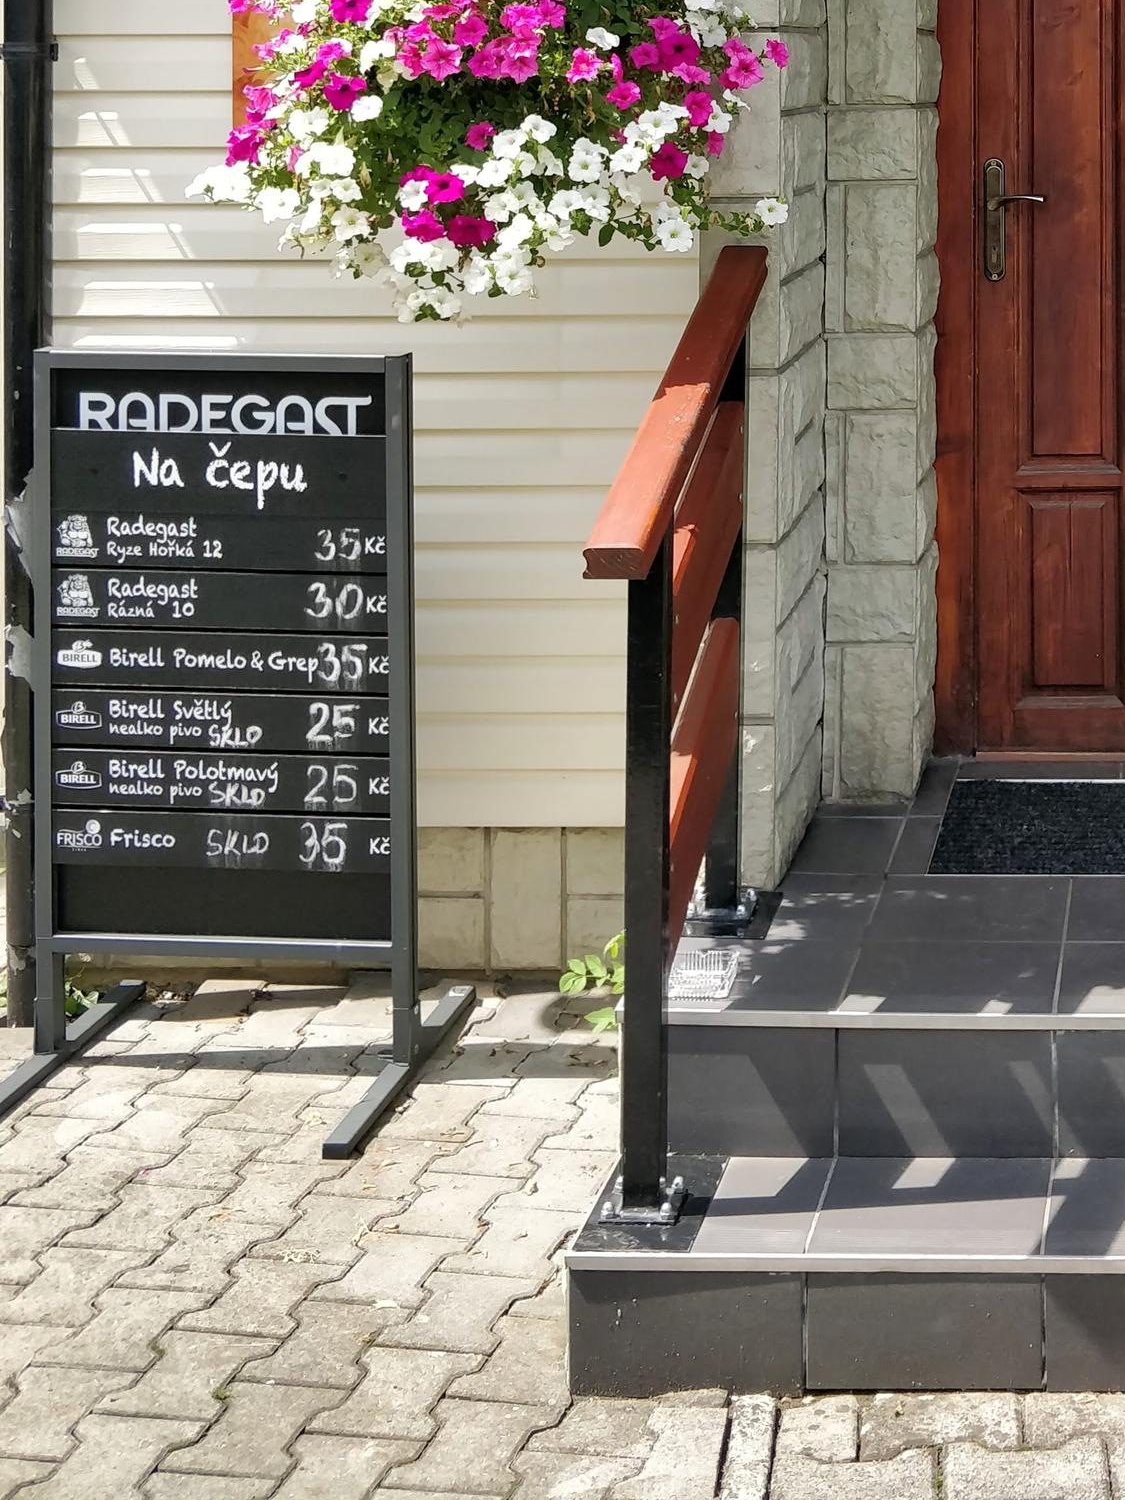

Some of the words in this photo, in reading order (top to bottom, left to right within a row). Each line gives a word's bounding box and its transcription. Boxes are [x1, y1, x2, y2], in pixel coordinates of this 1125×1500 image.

[79, 391, 372, 436] RADEGAST
[133, 448, 184, 487] Na
[205, 441, 307, 509] čepu
[106, 516, 197, 542] Radegast
[107, 542, 143, 563] Ryze
[149, 541, 195, 558] Hořká
[202, 540, 223, 559] 12
[314, 528, 361, 562] 35
[364, 536, 386, 554] Kč
[107, 577, 198, 603] Radegast
[306, 582, 364, 619] 30
[366, 596, 387, 613] Kč
[107, 604, 154, 618] Rázná
[172, 603, 194, 617] 10
[62, 653, 98, 663] BIRELL
[110, 648, 165, 668] Birell
[174, 649, 247, 670] Pomelo
[250, 651, 263, 671] &
[267, 652, 319, 683] Grep
[318, 643, 367, 681] 35
[368, 657, 390, 674] Kč
[60, 714, 97, 724] BIRELL
[109, 699, 165, 719] Birell
[173, 698, 232, 726] Světlý
[305, 702, 360, 742] 25
[368, 717, 390, 735] Kč
[109, 722, 163, 737] nealko
[169, 723, 202, 744] pivo
[60, 774, 97, 784] BIRELL
[109, 759, 165, 779] Birell
[174, 761, 279, 793] Polotmavý
[303, 764, 359, 803] 25
[368, 777, 391, 795] Kč
[109, 782, 163, 797] nealko
[169, 783, 202, 804] pivo
[56, 832, 103, 847] FRISCO
[110, 828, 176, 849] Frisco
[299, 821, 348, 864] 35
[369, 836, 391, 855] Kč
